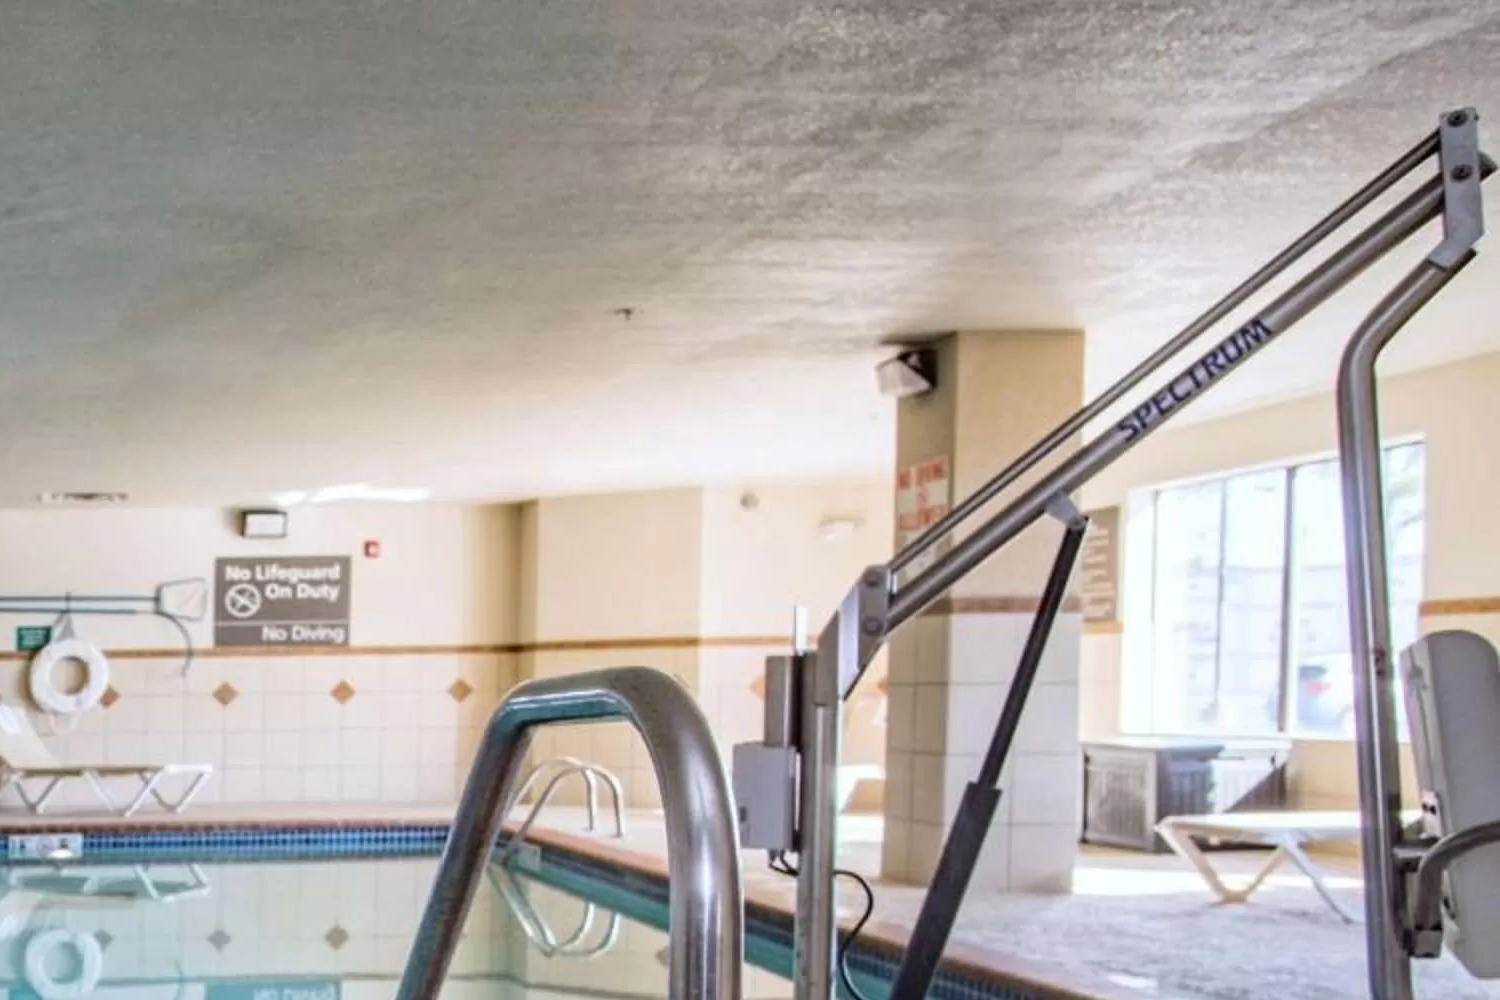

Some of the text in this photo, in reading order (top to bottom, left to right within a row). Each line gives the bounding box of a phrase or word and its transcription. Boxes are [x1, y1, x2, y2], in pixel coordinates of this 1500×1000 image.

[1117, 317, 1273, 442] SPECTRUM
[225, 563, 341, 583] No Lifeguard
[265, 583, 341, 602] On Duty
[262, 625, 345, 643] No Diving
